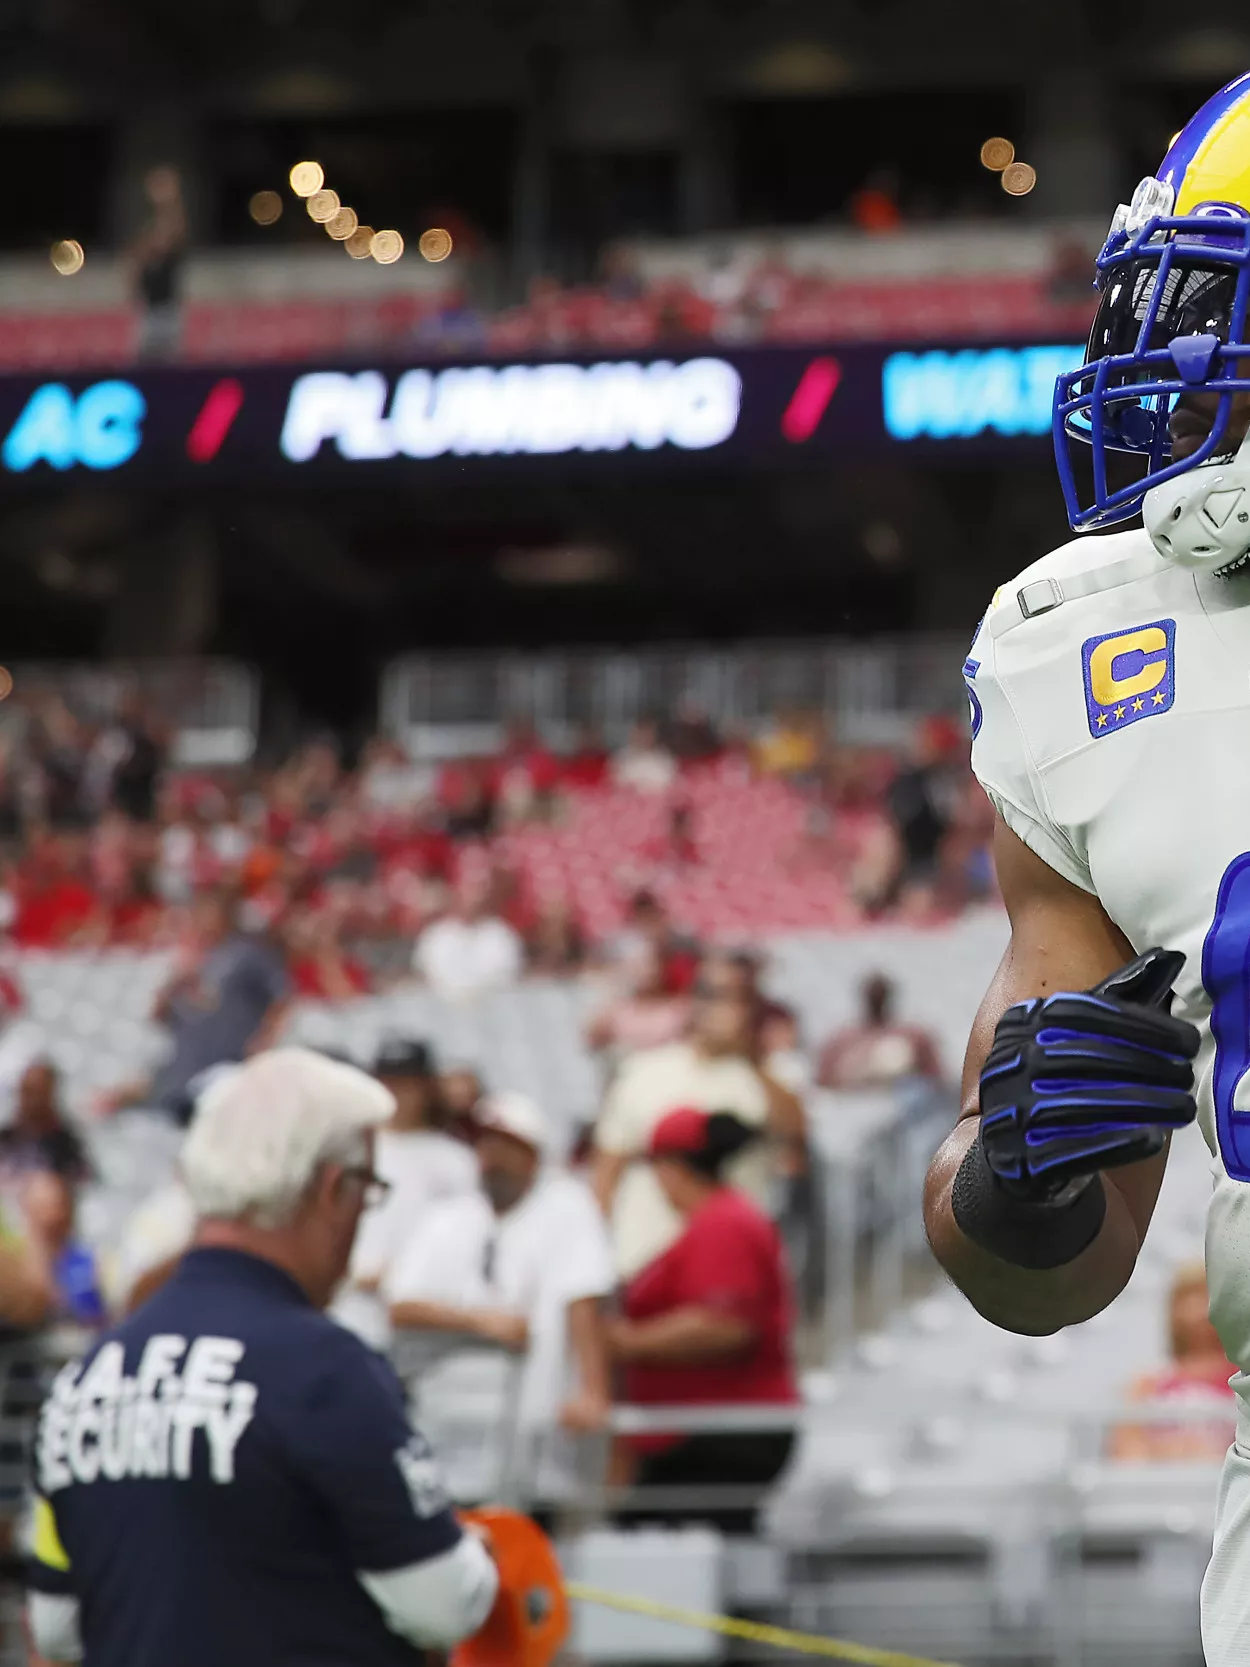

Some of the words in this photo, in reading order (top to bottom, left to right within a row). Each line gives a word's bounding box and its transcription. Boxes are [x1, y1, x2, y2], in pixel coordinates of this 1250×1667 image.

[3, 381, 146, 471] AC
[280, 357, 742, 462] PLUMBING
[881, 345, 1088, 440] WAT
[1089, 627, 1168, 707] C
[36, 1397, 254, 1493] ECURITY
